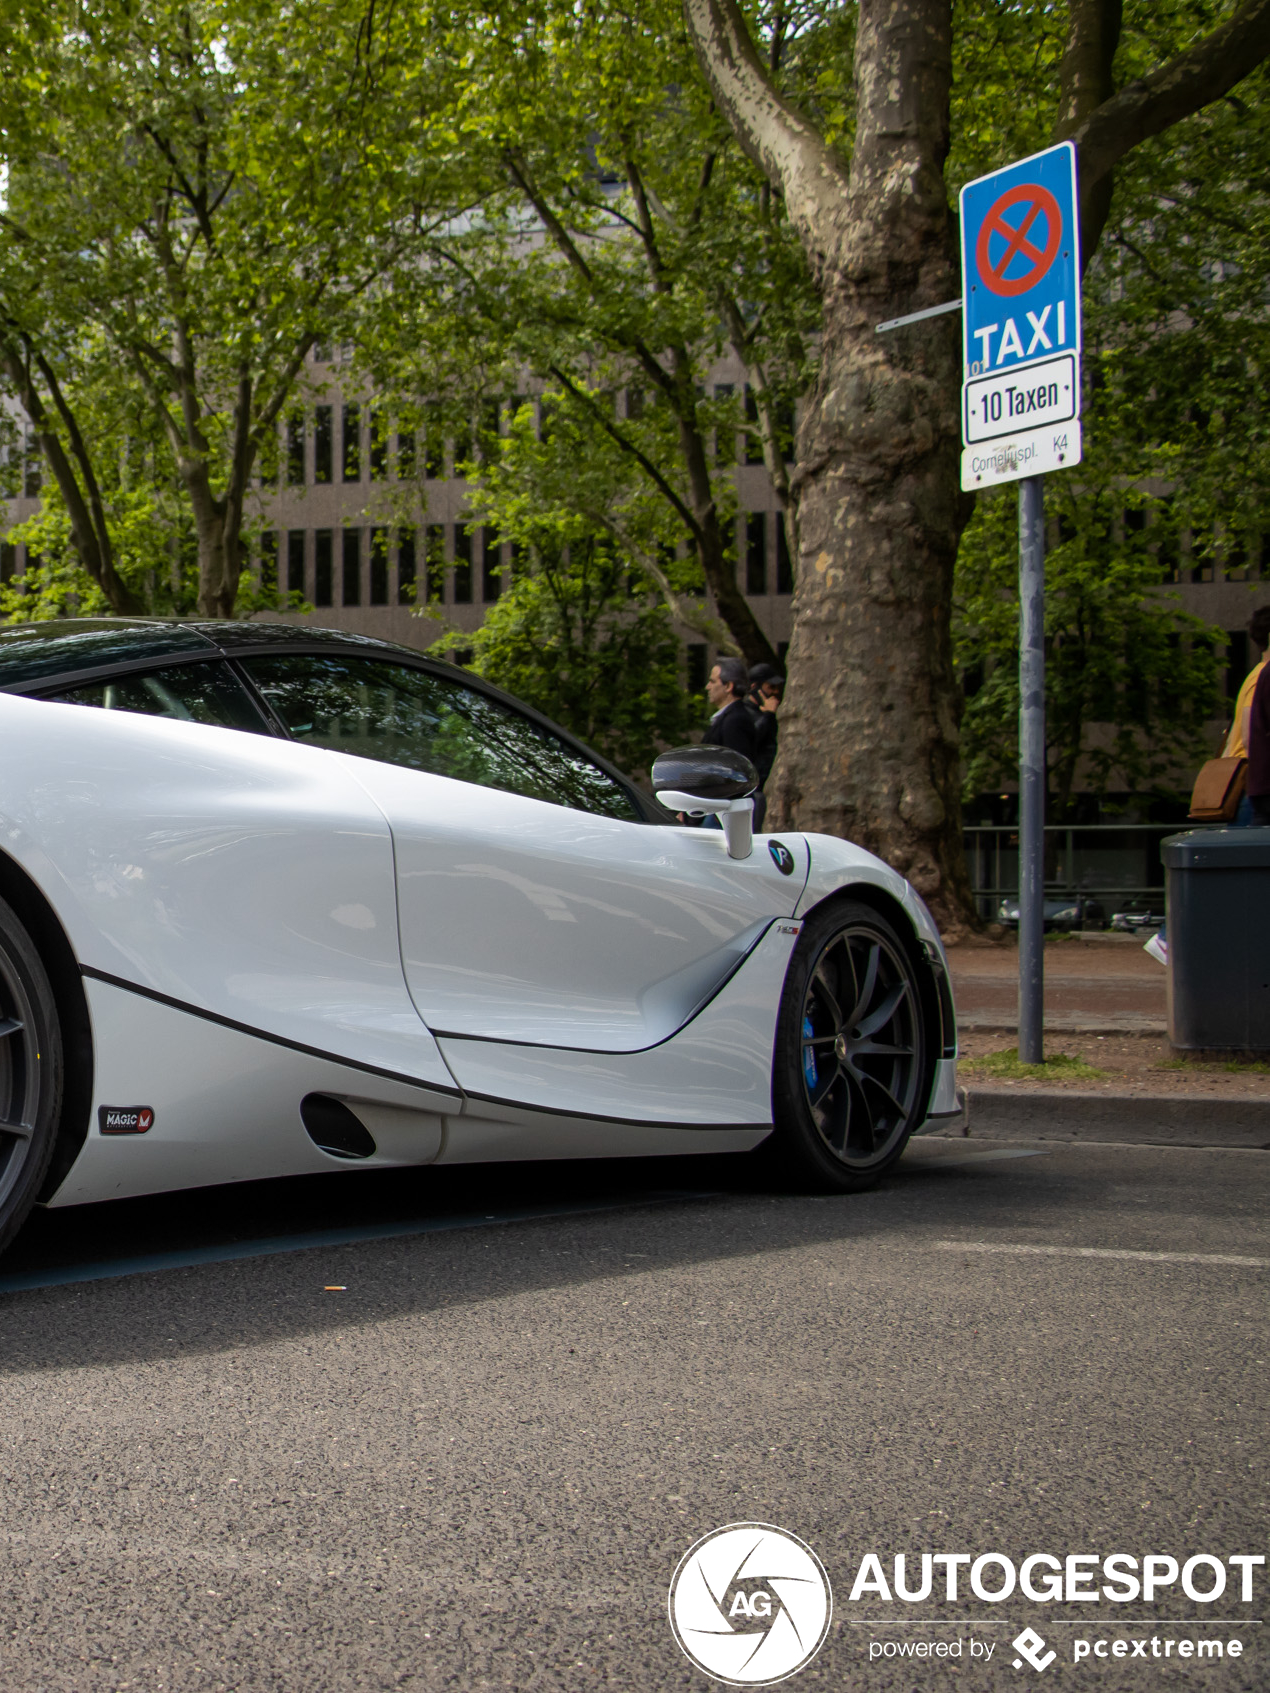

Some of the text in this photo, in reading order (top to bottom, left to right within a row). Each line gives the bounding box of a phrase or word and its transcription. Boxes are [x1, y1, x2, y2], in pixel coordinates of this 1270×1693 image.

[973, 300, 1066, 370] TAXI
[981, 382, 1058, 423] 10 Taxen
[1053, 434, 1068, 452] K4
